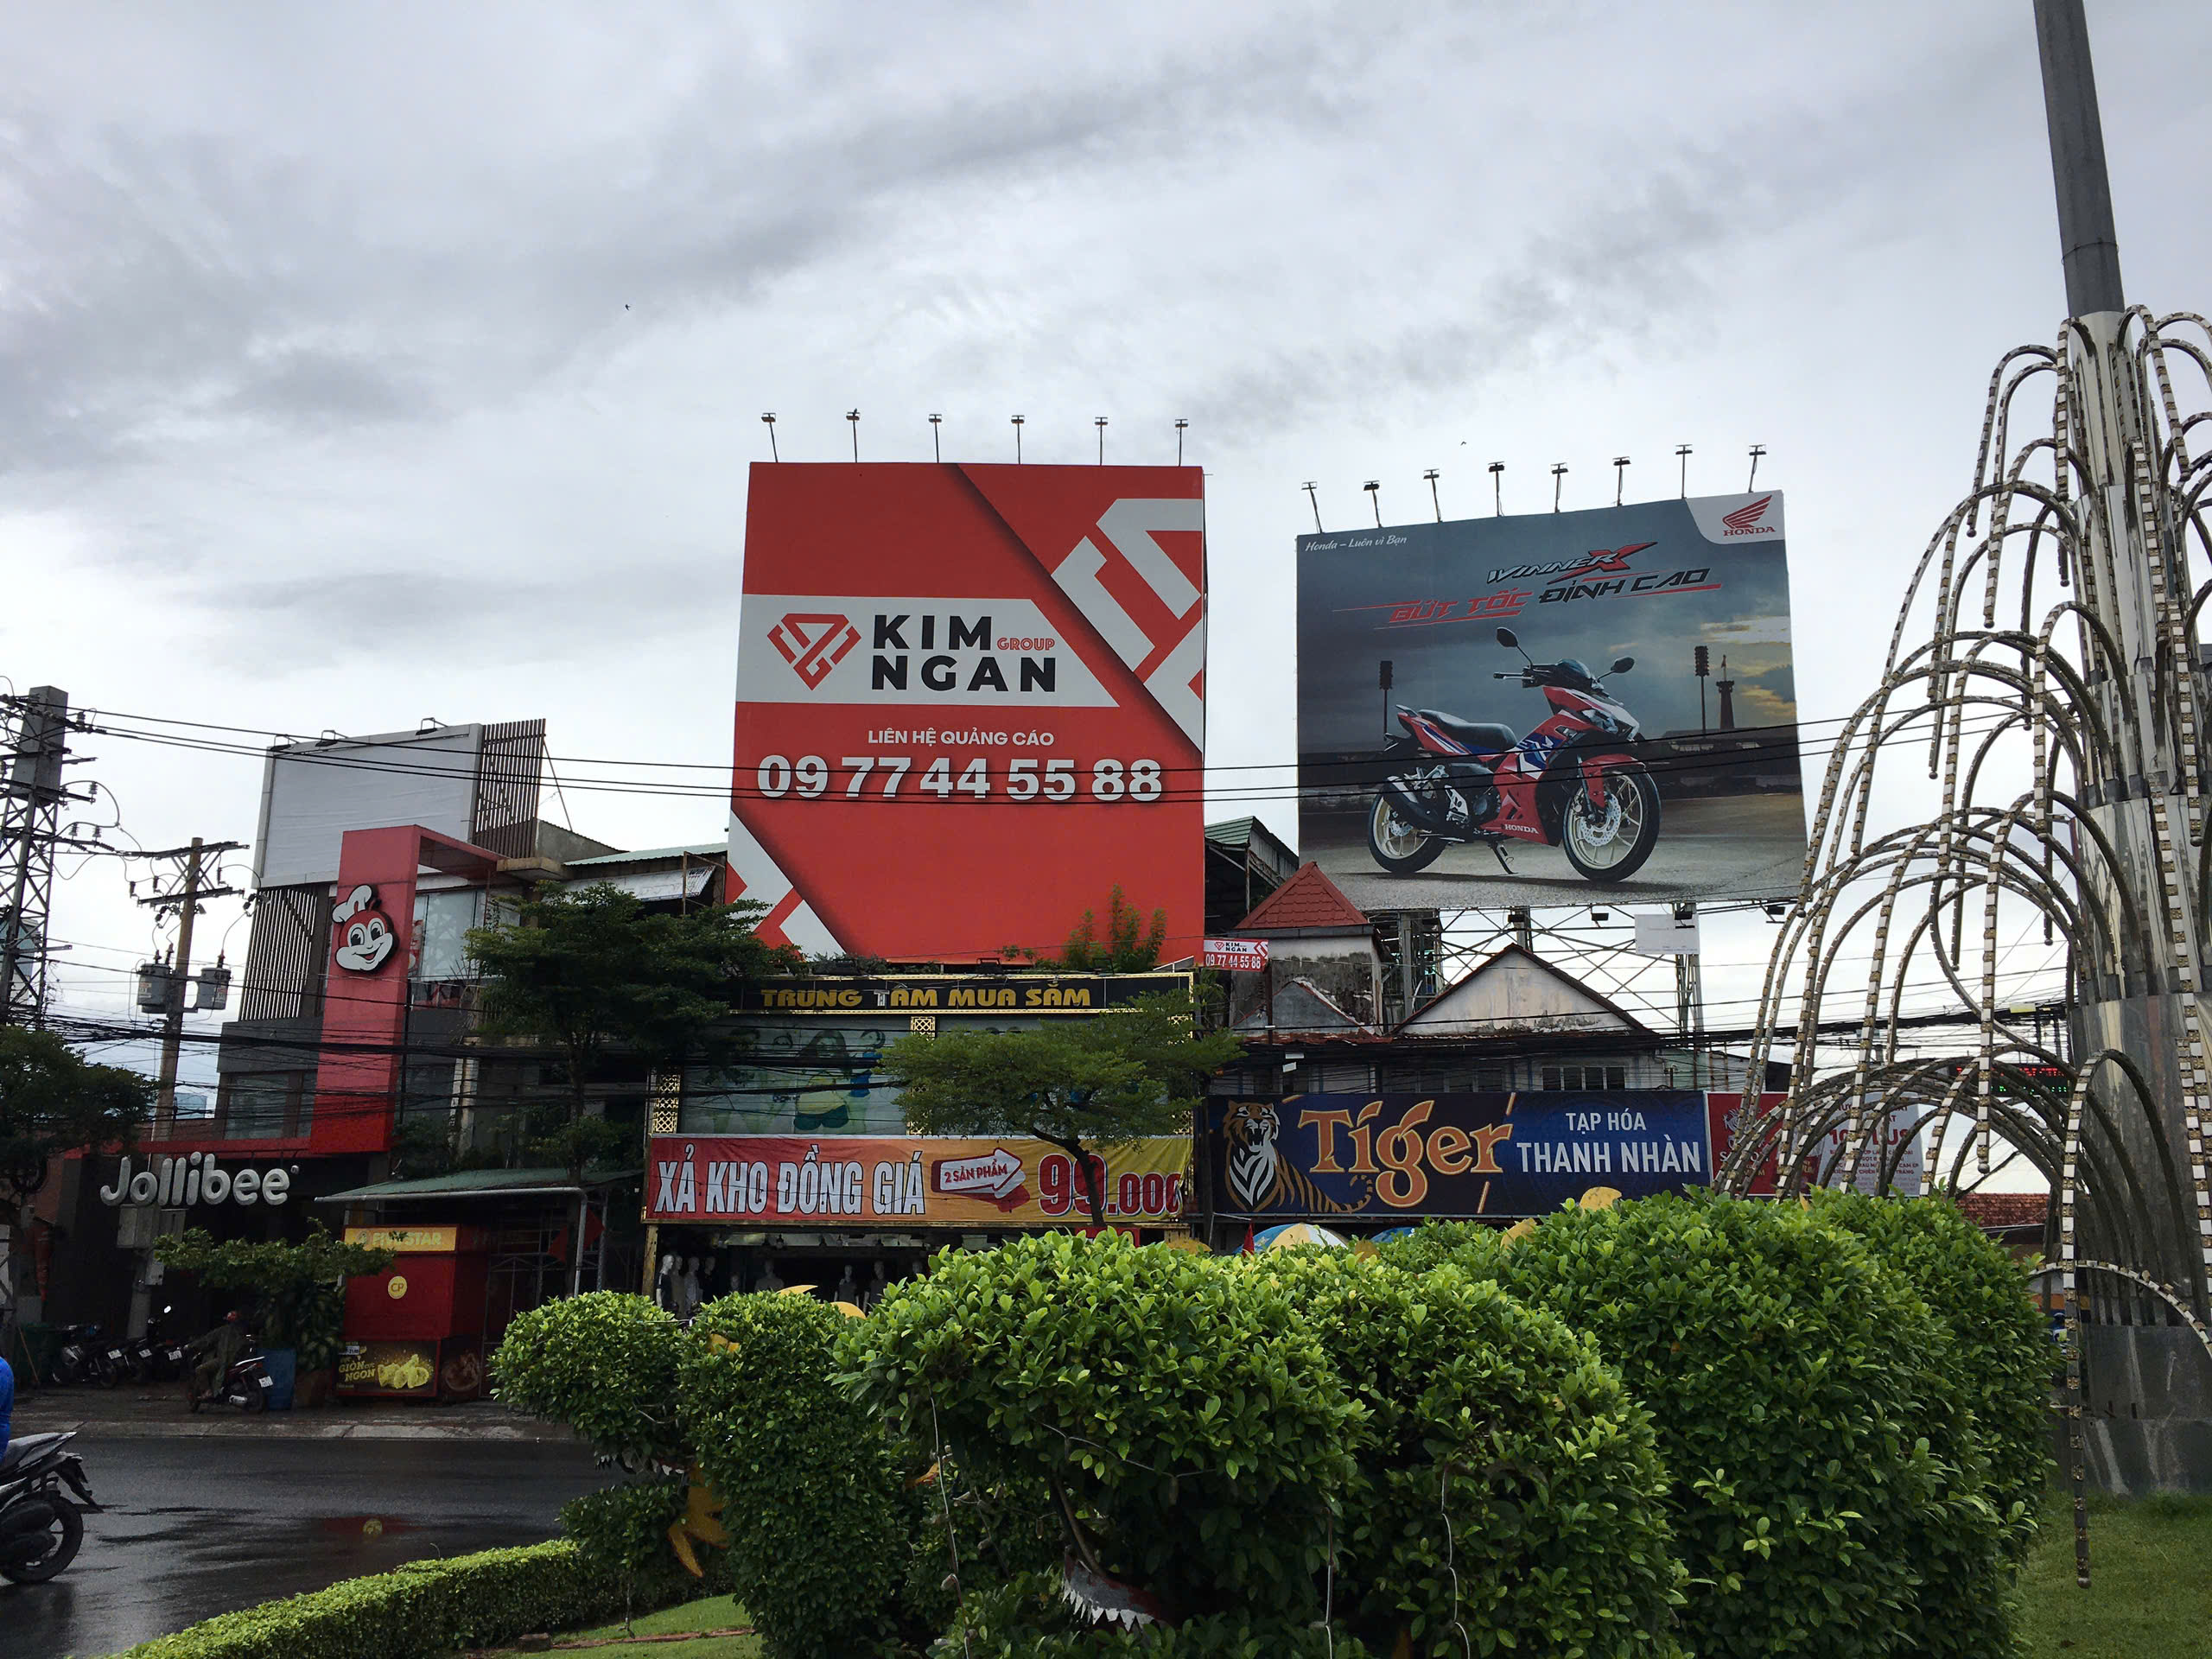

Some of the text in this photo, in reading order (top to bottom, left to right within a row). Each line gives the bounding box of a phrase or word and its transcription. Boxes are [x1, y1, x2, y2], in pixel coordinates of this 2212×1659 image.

[1305, 540, 1338, 552] Honda
[1348, 537, 1372, 548] Luôn
[1375, 536, 1384, 546] vì
[1387, 534, 1407, 547] Bạn
[1723, 526, 1776, 537] HONDA
[1538, 579, 1625, 604] ĐỈNH
[1630, 567, 1710, 593] CAO
[874, 614, 992, 651] KIM
[997, 636, 1055, 652] GROUP
[872, 655, 1057, 693] NGAN
[868, 727, 1055, 747] LIÊN HỆ QUẢNG CÁO
[757, 754, 1162, 802] 09 77 44 55 88
[1503, 823, 1539, 835] HONDA
[1205, 954, 1261, 969] 09 77 44 55 88
[760, 988, 862, 1007] TRUNG
[874, 983, 938, 1007] TÂM
[948, 988, 1017, 1007] MUA
[1565, 1106, 1647, 1135] TẠP HÓA
[1297, 1099, 1514, 1208] Tiger
[1516, 1133, 1701, 1173] THANH NHÀN
[99, 1151, 290, 1207] Jollibee
[653, 1142, 926, 1215] XẢ KHO ĐỒNG GIÁ
[944, 1159, 1008, 1183] 2 SẢN PHẨM
[406, 1231, 442, 1246] STAR
[391, 1283, 404, 1292] CP
[345, 1369, 376, 1382] NGON
